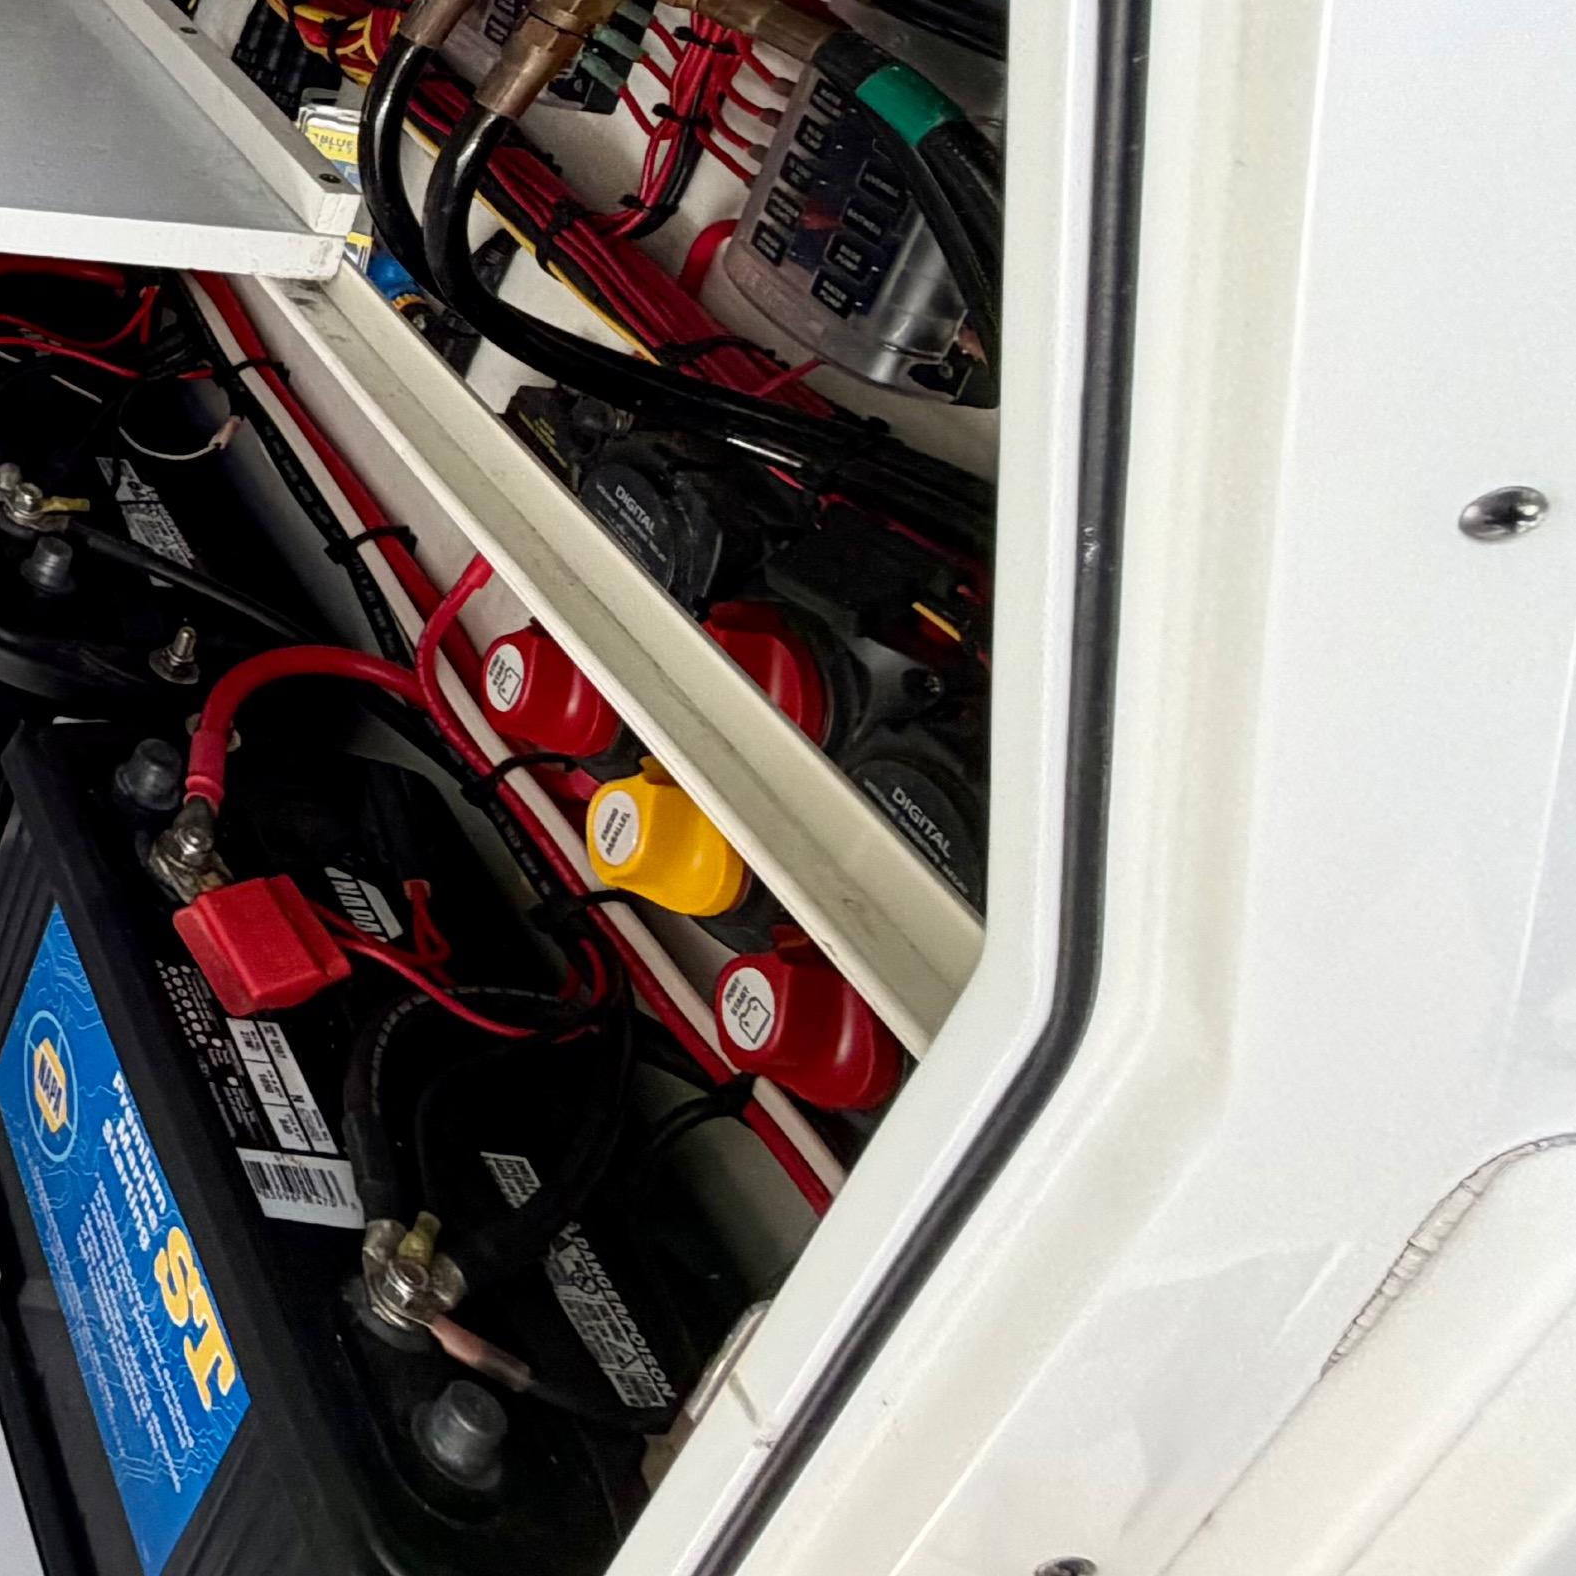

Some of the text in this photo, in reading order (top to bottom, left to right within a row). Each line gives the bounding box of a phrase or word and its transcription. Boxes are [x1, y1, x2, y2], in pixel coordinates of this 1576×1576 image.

[614, 485, 656, 537] DIGITAL
[888, 784, 958, 860] DIGITAL
[35, 1057, 64, 1120] NAPA
[113, 1070, 167, 1213] Premium
[102, 1119, 150, 1252] Starting
[117, 1117, 159, 1231] Marine
[154, 1225, 238, 1412] ST
